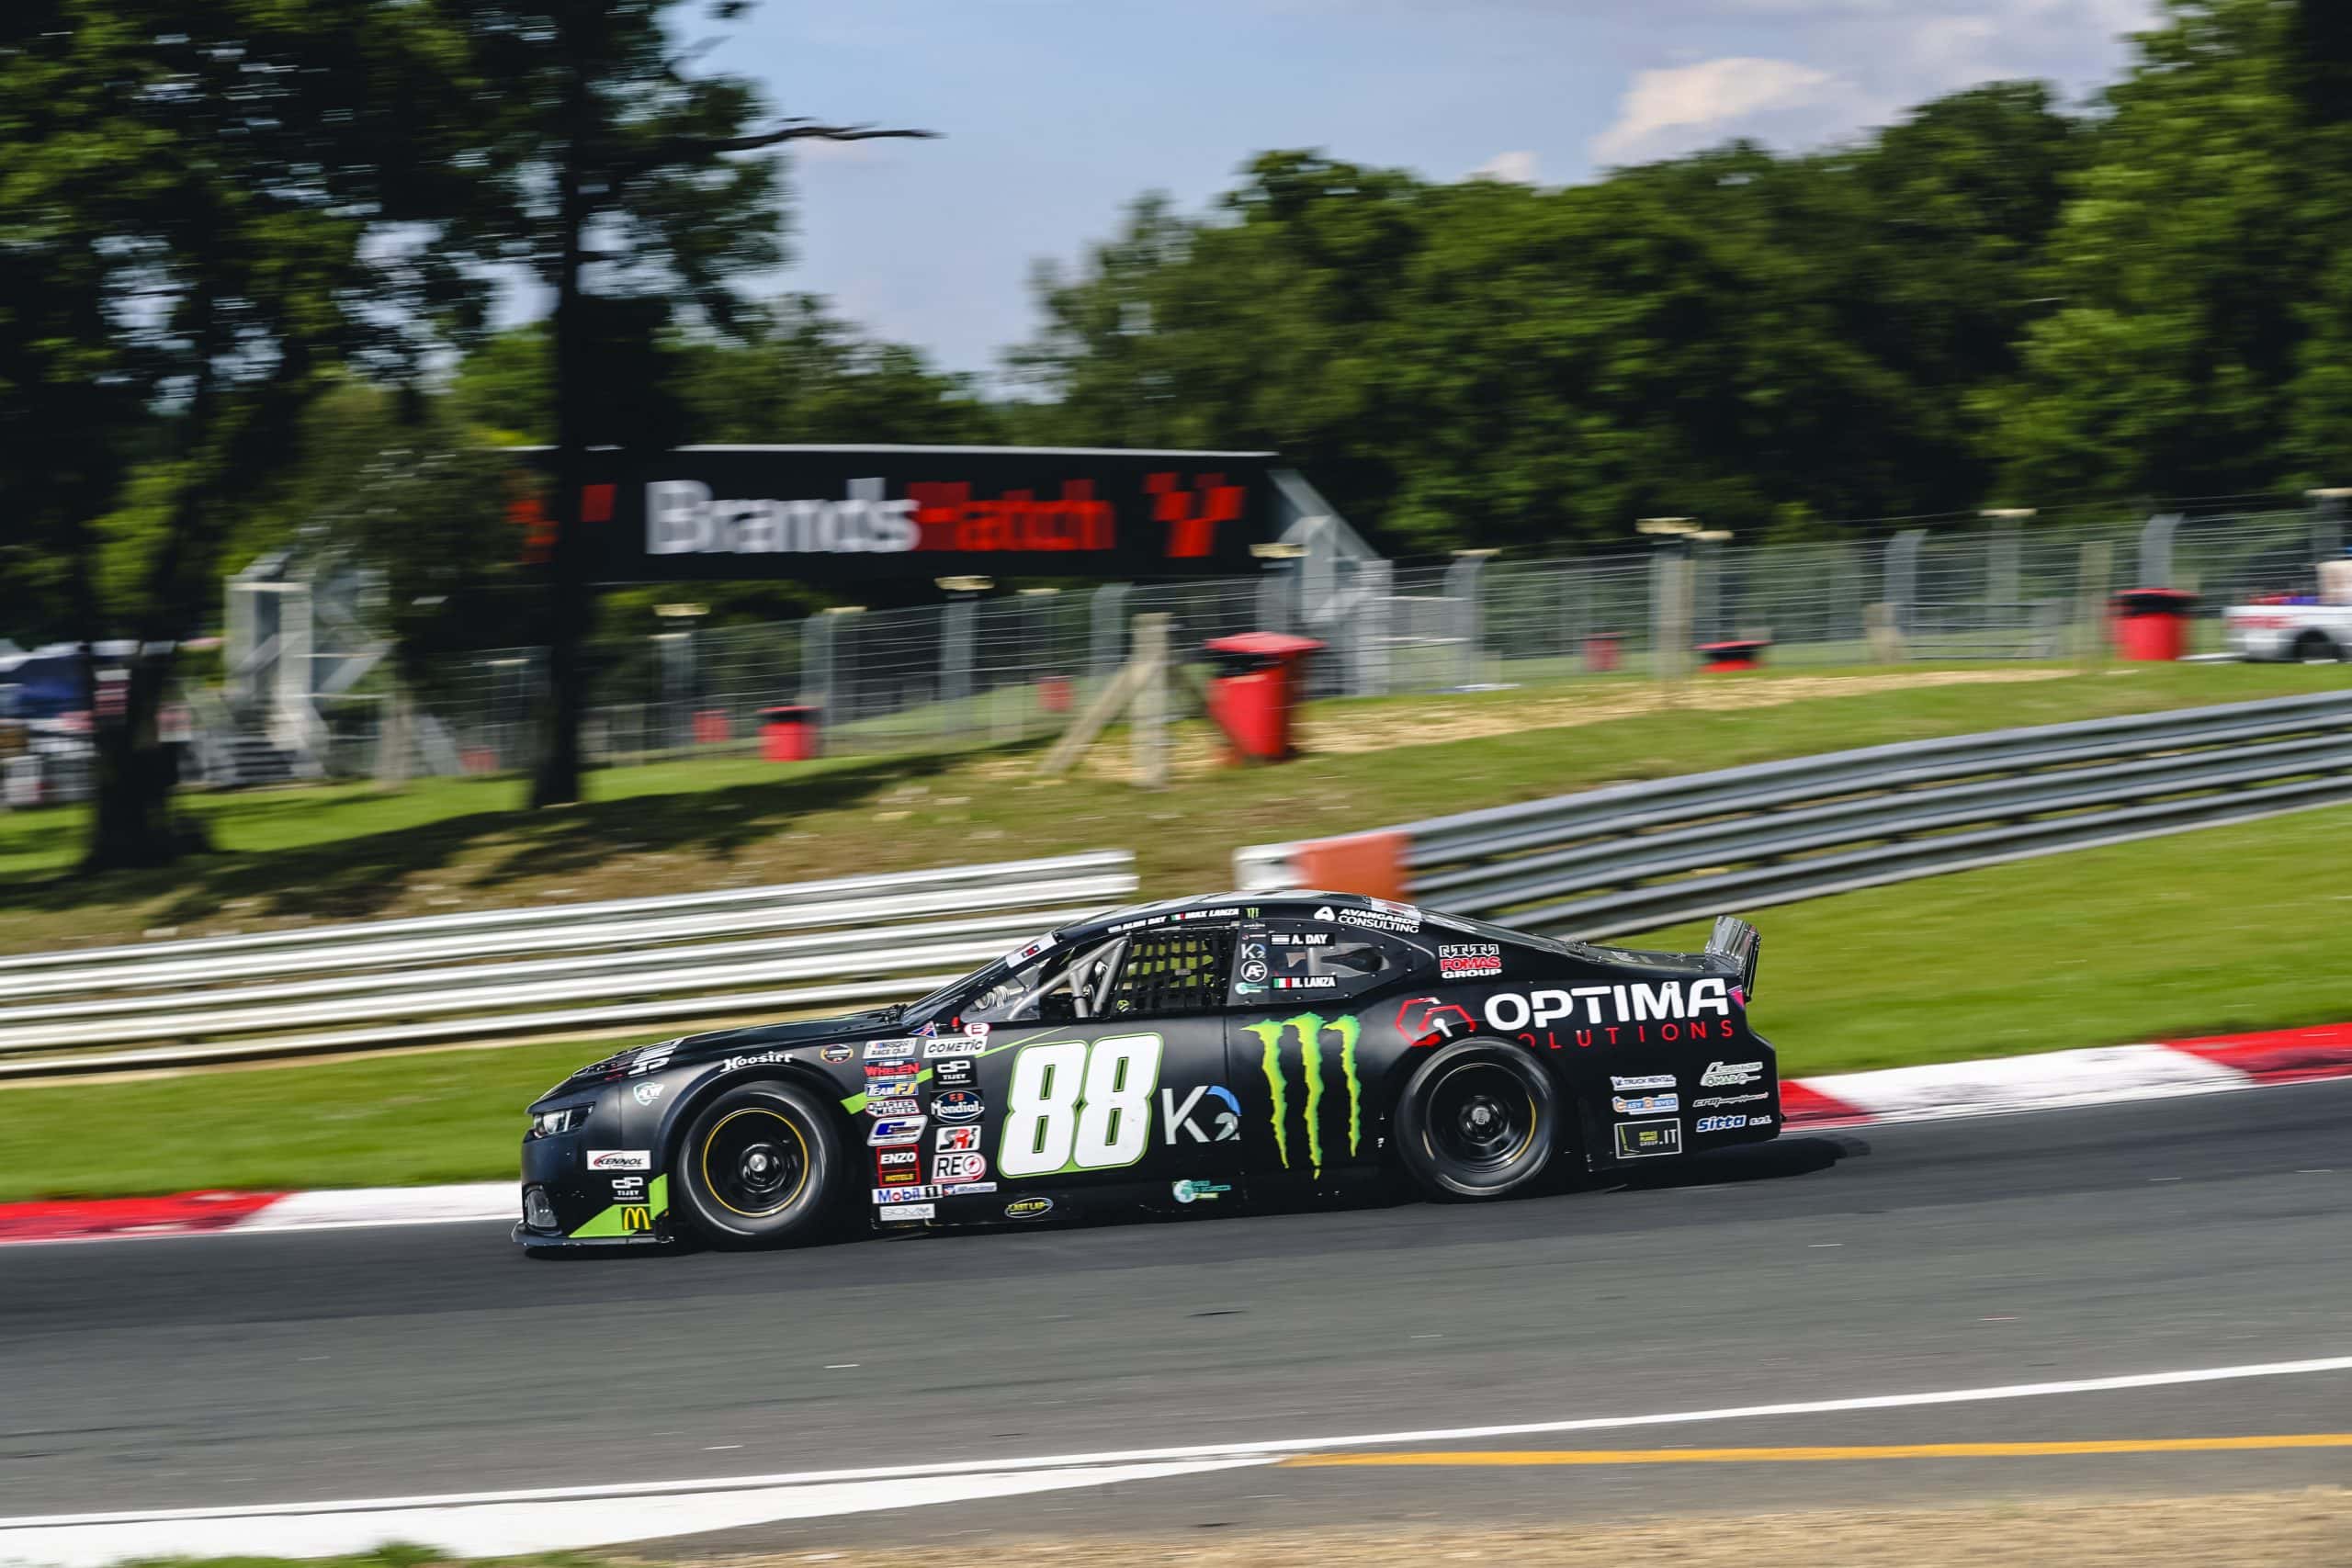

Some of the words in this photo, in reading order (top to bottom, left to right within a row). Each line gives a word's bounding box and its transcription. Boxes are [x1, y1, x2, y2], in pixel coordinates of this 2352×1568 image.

[1338, 915, 1419, 933] CONSULTING
[1340, 908, 1419, 925] AVANGARDE
[1306, 934, 1328, 944] DAY
[1440, 956, 1501, 972] FOMAS
[1442, 968, 1502, 978] GROUP
[1305, 976, 1336, 987] LANZA
[1485, 977, 1729, 1031] OPTIMA
[719, 1050, 794, 1073] Hoosier
[998, 1033, 1162, 1178] 88
[1697, 1114, 1747, 1131] Sitta
[597, 1157, 643, 1166] KENNOL
[880, 1152, 917, 1165] ENZO
[877, 1188, 922, 1202] Mobil
